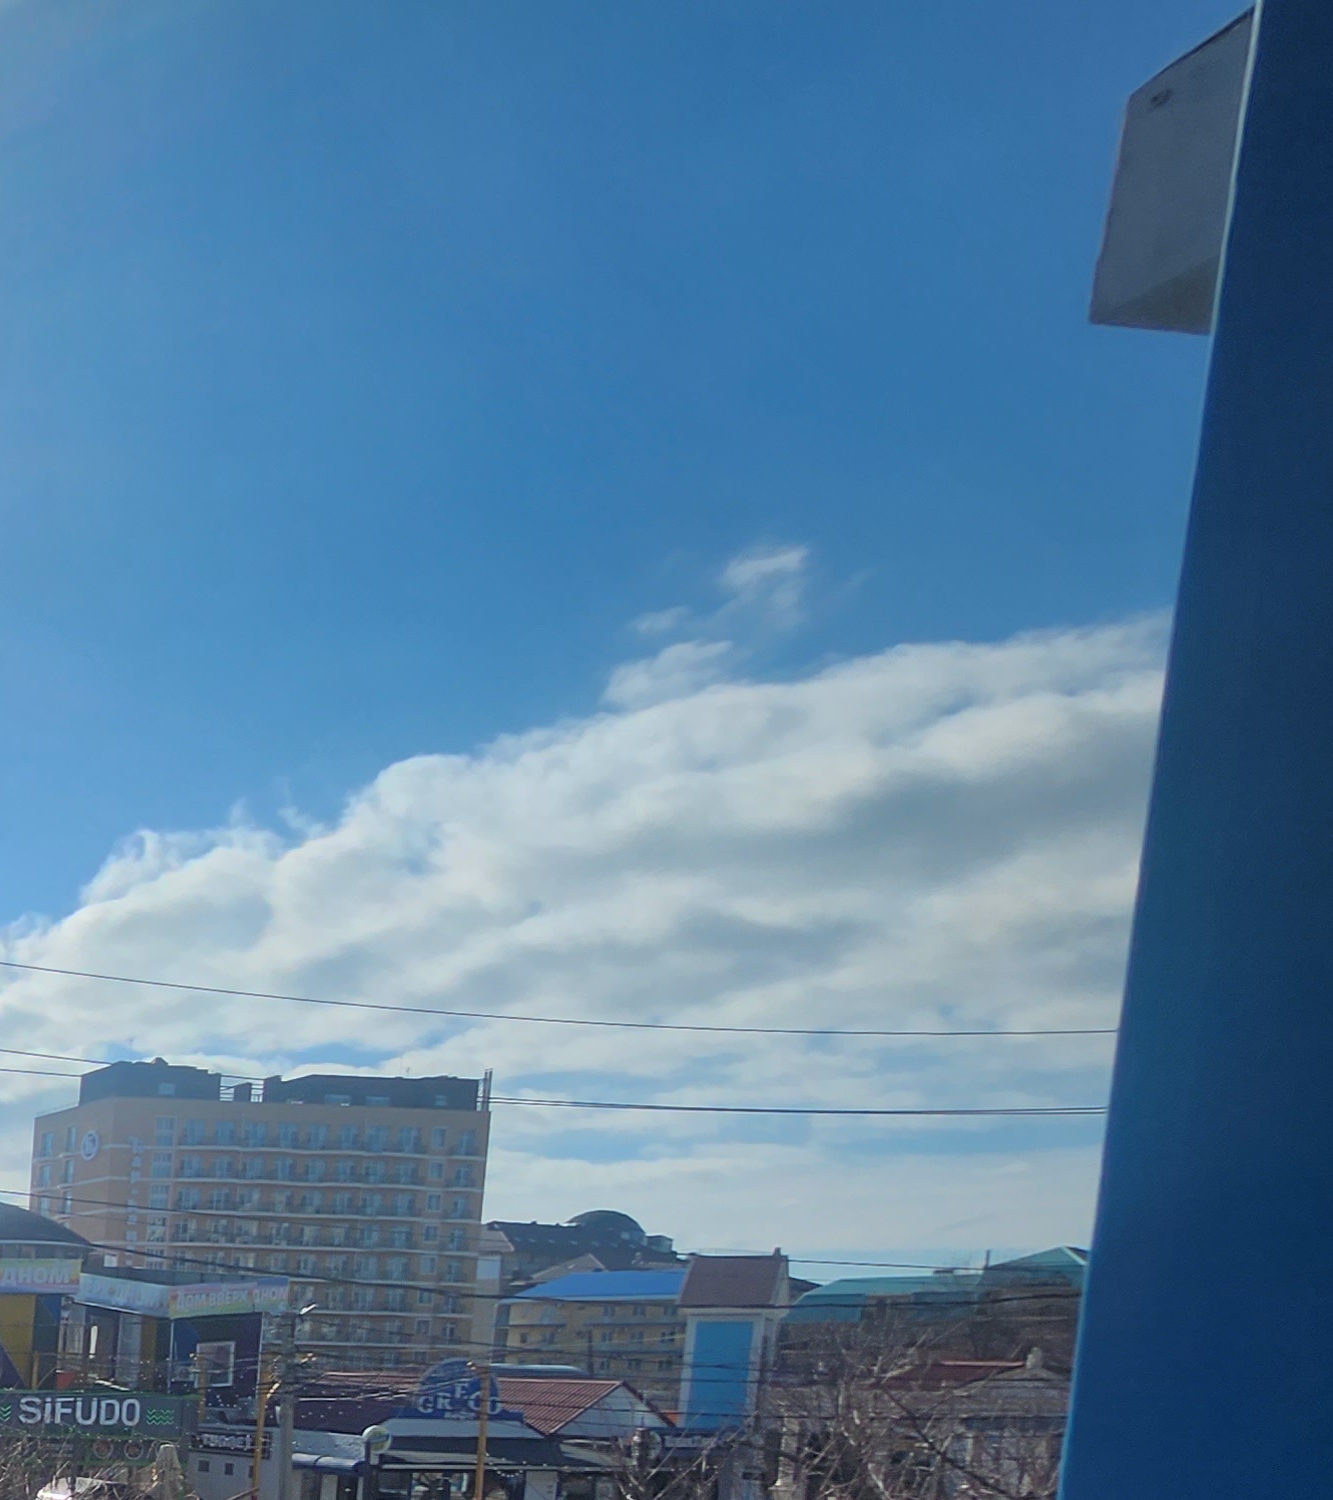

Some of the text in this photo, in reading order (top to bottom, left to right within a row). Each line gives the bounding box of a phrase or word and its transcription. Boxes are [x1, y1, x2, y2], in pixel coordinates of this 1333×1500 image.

[1, 1266, 70, 1287] ДНОМ
[177, 1288, 208, 1309] ДОМ
[210, 1288, 248, 1307] ВВЕРХ
[253, 1286, 289, 1304] ДНОМ
